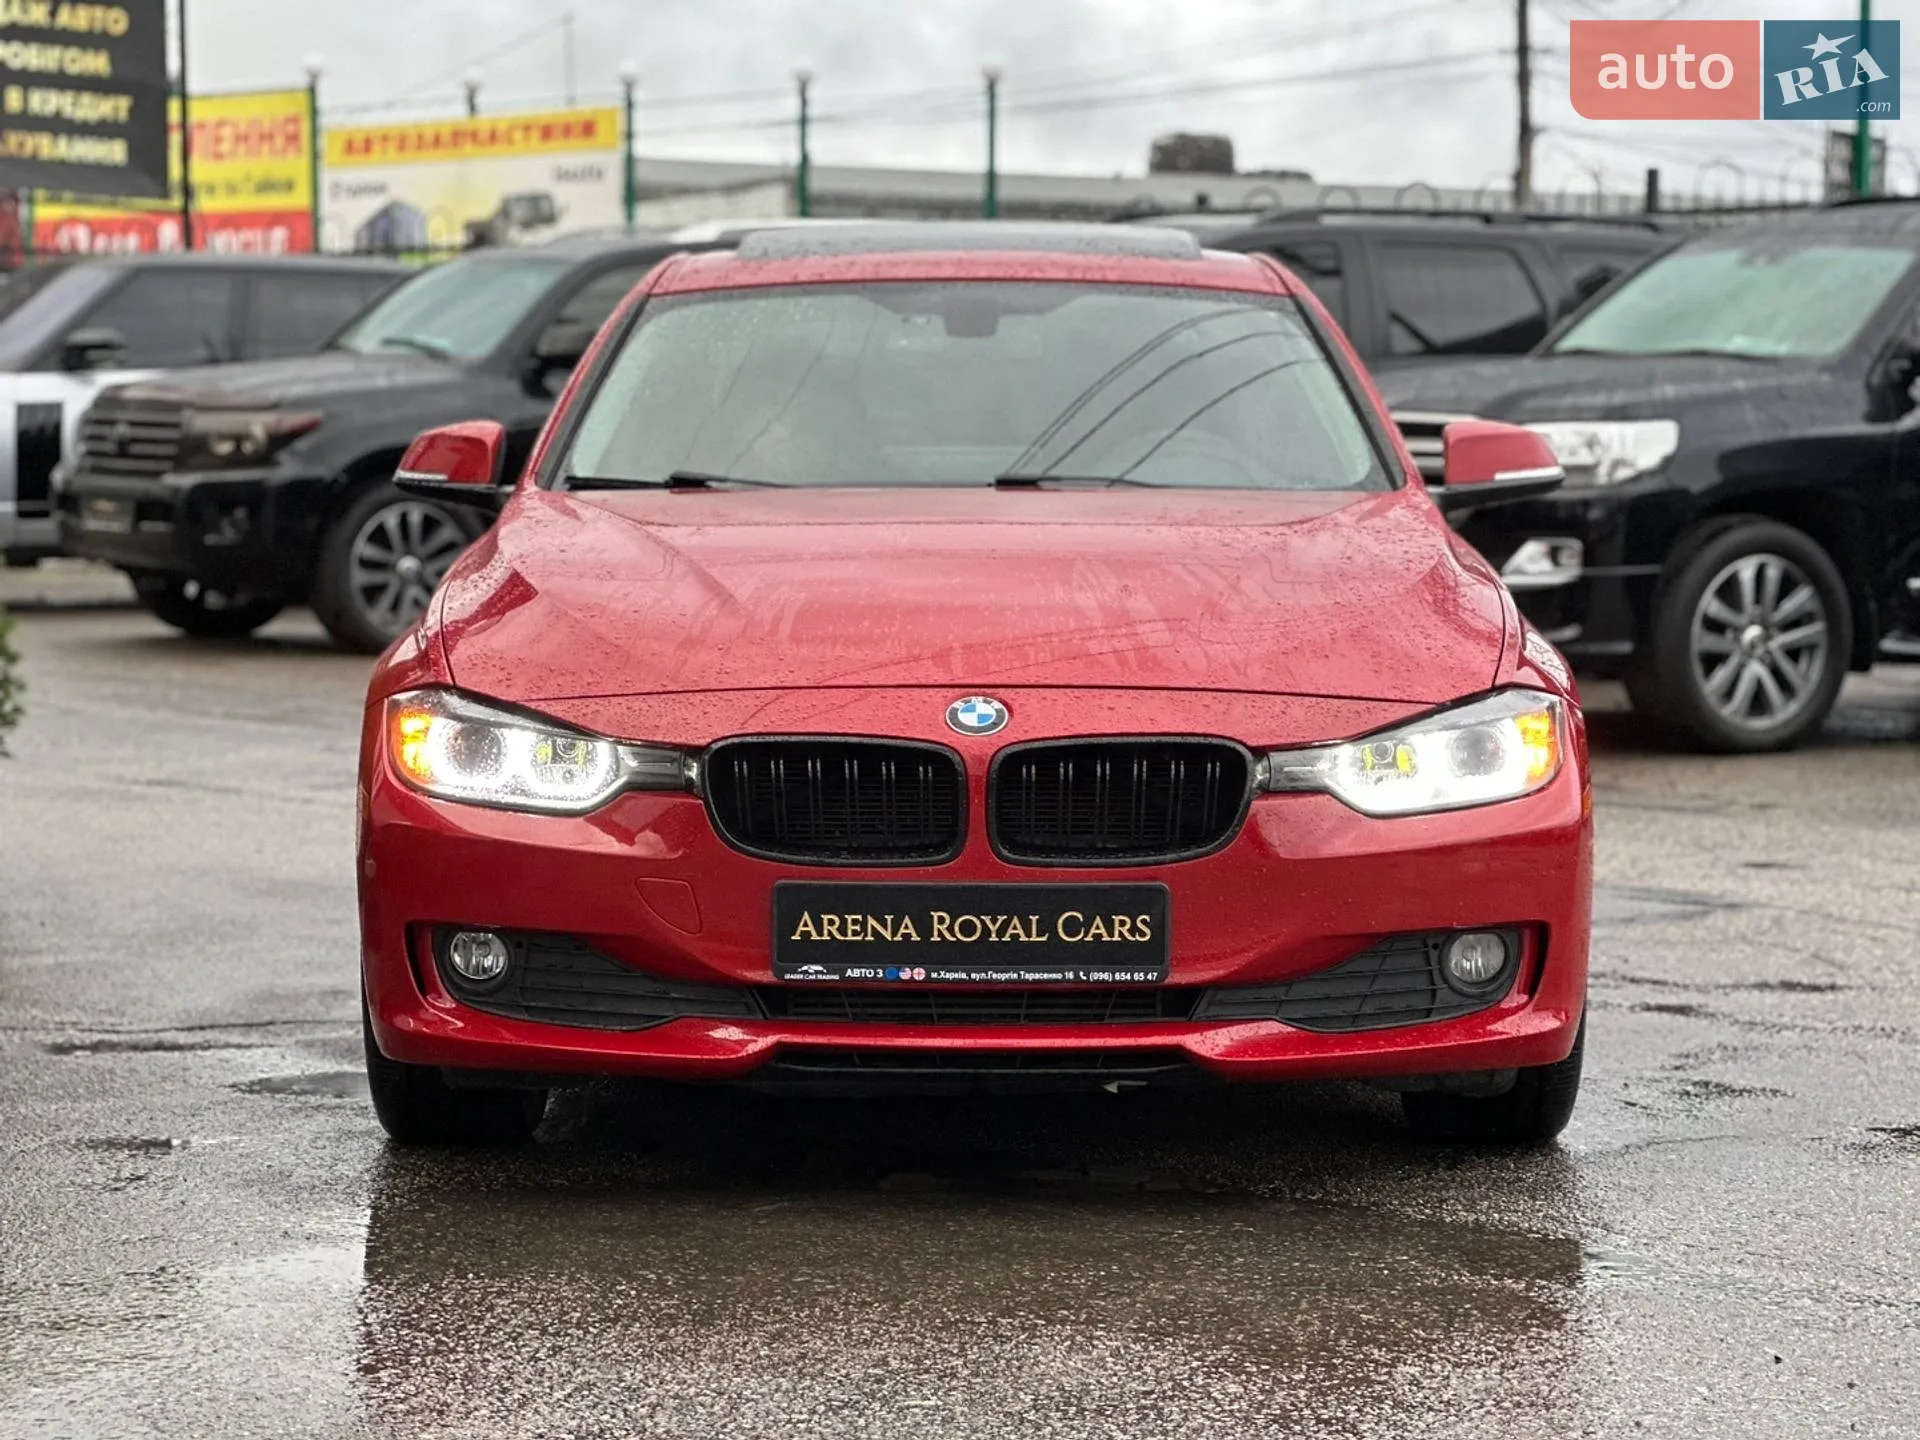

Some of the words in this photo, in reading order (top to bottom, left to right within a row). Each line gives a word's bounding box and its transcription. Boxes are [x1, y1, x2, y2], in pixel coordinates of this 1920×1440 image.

[55, 3, 130, 37] АВТО
[27, 88, 133, 125] КРЕДИТ
[1115, 972, 1131, 981] 654
[1134, 972, 1145, 981] 65
[1147, 972, 1158, 981] 47
